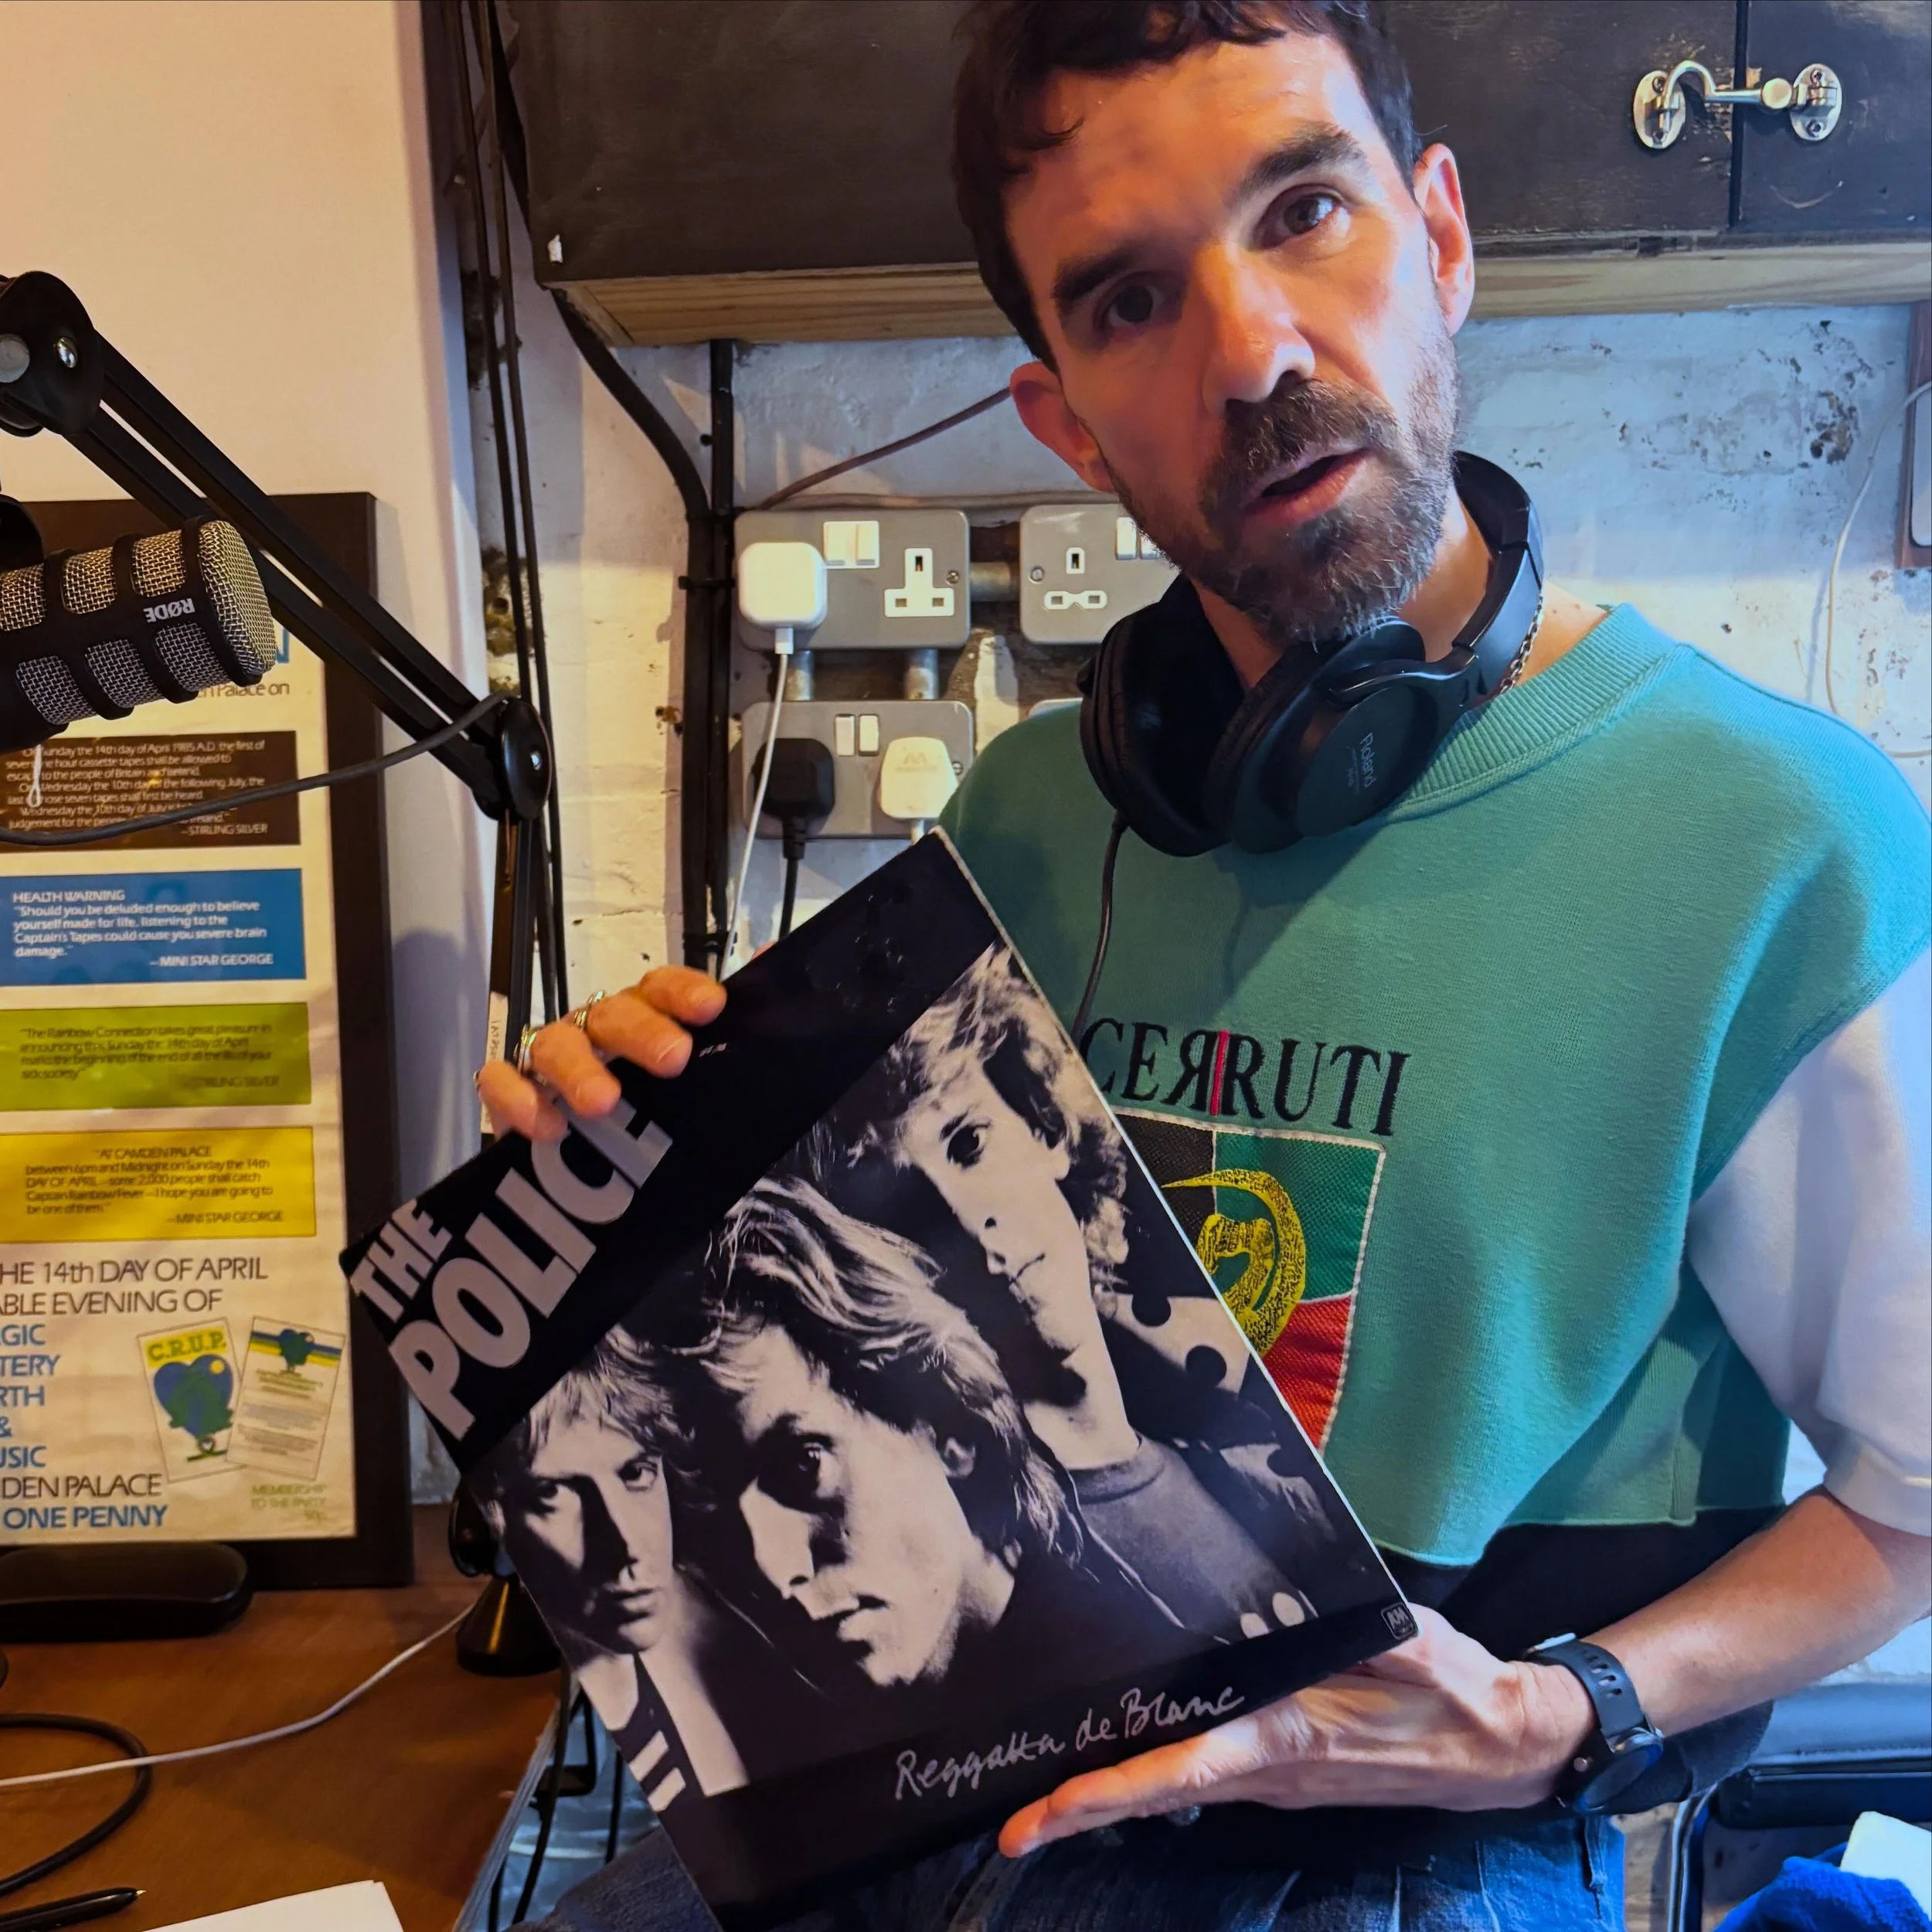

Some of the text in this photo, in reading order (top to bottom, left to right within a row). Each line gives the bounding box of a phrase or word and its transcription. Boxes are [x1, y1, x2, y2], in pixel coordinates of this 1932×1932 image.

[143, 598, 196, 623] RØDE
[268, 682, 290, 695] on
[77, 746, 94, 755] the
[117, 744, 135, 757] day
[55, 758, 77, 768] hour
[79, 757, 117, 767] cassette
[119, 756, 145, 770] tapes
[169, 755, 180, 764] be
[182, 754, 220, 764] allowed
[221, 754, 231, 764] to
[1360, 732, 1376, 788] Roland
[53, 770, 69, 781] the
[70, 770, 103, 782] people
[180, 777, 226, 791] following
[249, 777, 265, 787] the
[65, 794, 92, 804] seven
[94, 794, 119, 805] tapes
[77, 806, 94, 816] the
[117, 804, 135, 816] day
[9, 819, 60, 832] judgement
[13, 889, 126, 903] HEALTH WARNING
[63, 906, 87, 918] you
[87, 904, 102, 915] be
[104, 903, 155, 915] deluded
[155, 902, 201, 915] enough
[202, 901, 216, 912] to
[217, 900, 260, 912] believe
[13, 918, 62, 933] yourself
[63, 918, 97, 929] made
[98, 917, 114, 927] for
[141, 916, 192, 929] listening
[194, 916, 207, 926] to
[208, 914, 229, 925] the
[69, 931, 103, 944] Tapes
[104, 930, 137, 941] could
[138, 930, 169, 940] cause
[171, 930, 194, 943] you
[195, 929, 233, 940] severe
[235, 927, 267, 939] brain
[190, 954, 219, 966] STAR
[220, 953, 274, 965] GEORGE
[1081, 1018, 1412, 1137] CERRUTI
[115, 1147, 169, 1159] CAMDEN
[170, 1146, 211, 1158] PALACE
[187, 1160, 225, 1172] Sunday
[247, 1158, 270, 1169] 14th
[26, 1177, 49, 1189] DAY
[49, 1176, 66, 1188] OF
[170, 1175, 206, 1185] people
[232, 1172, 261, 1183] catch
[229, 1186, 261, 1200] going
[262, 1185, 274, 1197] to
[233, 1210, 284, 1223] GEORGE
[44, 1260, 94, 1284] 14th
[100, 1259, 150, 1284] DAY
[155, 1258, 193, 1281] OF
[196, 1257, 270, 1281] APRIL
[349, 1096, 673, 1441] THE POLICE
[0, 1288, 223, 1315] BLE EVENING OF
[0, 1323, 46, 1346] GIC
[2, 1473, 162, 1499] DEN PALACE
[3, 1504, 168, 1530] ONE PENNY
[895, 1685, 1246, 1801] Reggatta de Blanc
